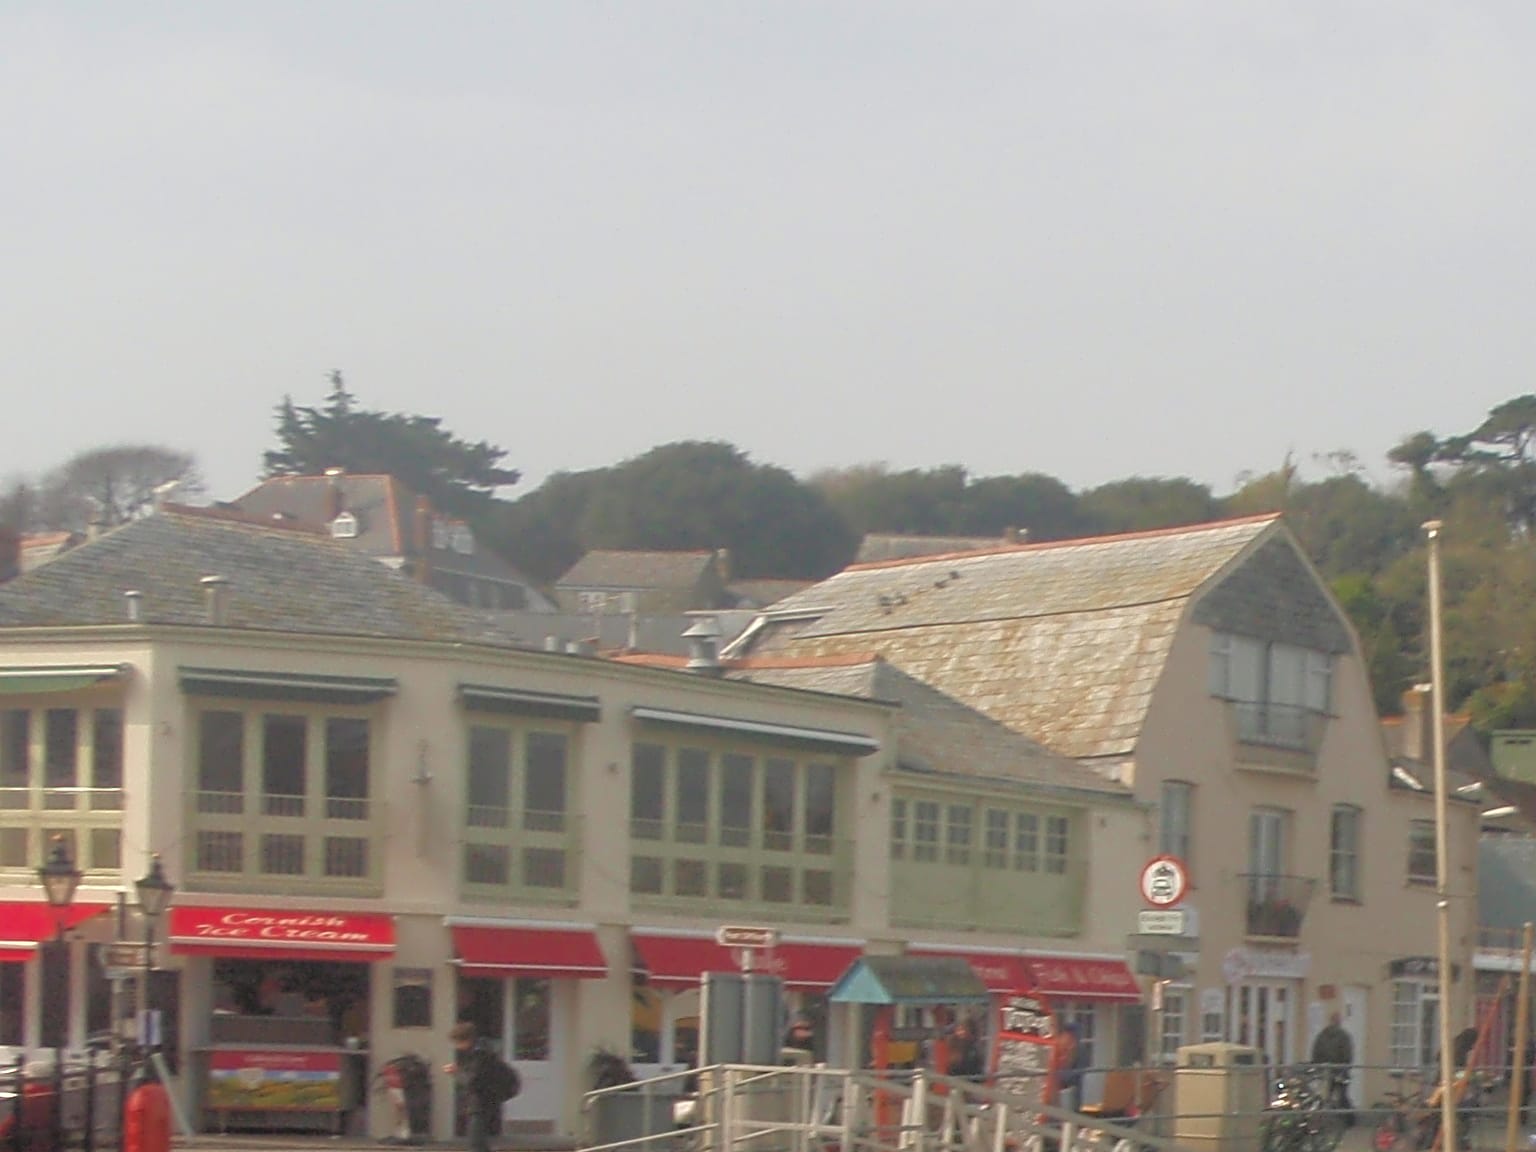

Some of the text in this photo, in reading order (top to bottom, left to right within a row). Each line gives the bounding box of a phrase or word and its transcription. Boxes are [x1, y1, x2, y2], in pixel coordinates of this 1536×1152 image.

[220, 913, 346, 926] Cornish
[196, 924, 370, 940] Ice Cream
